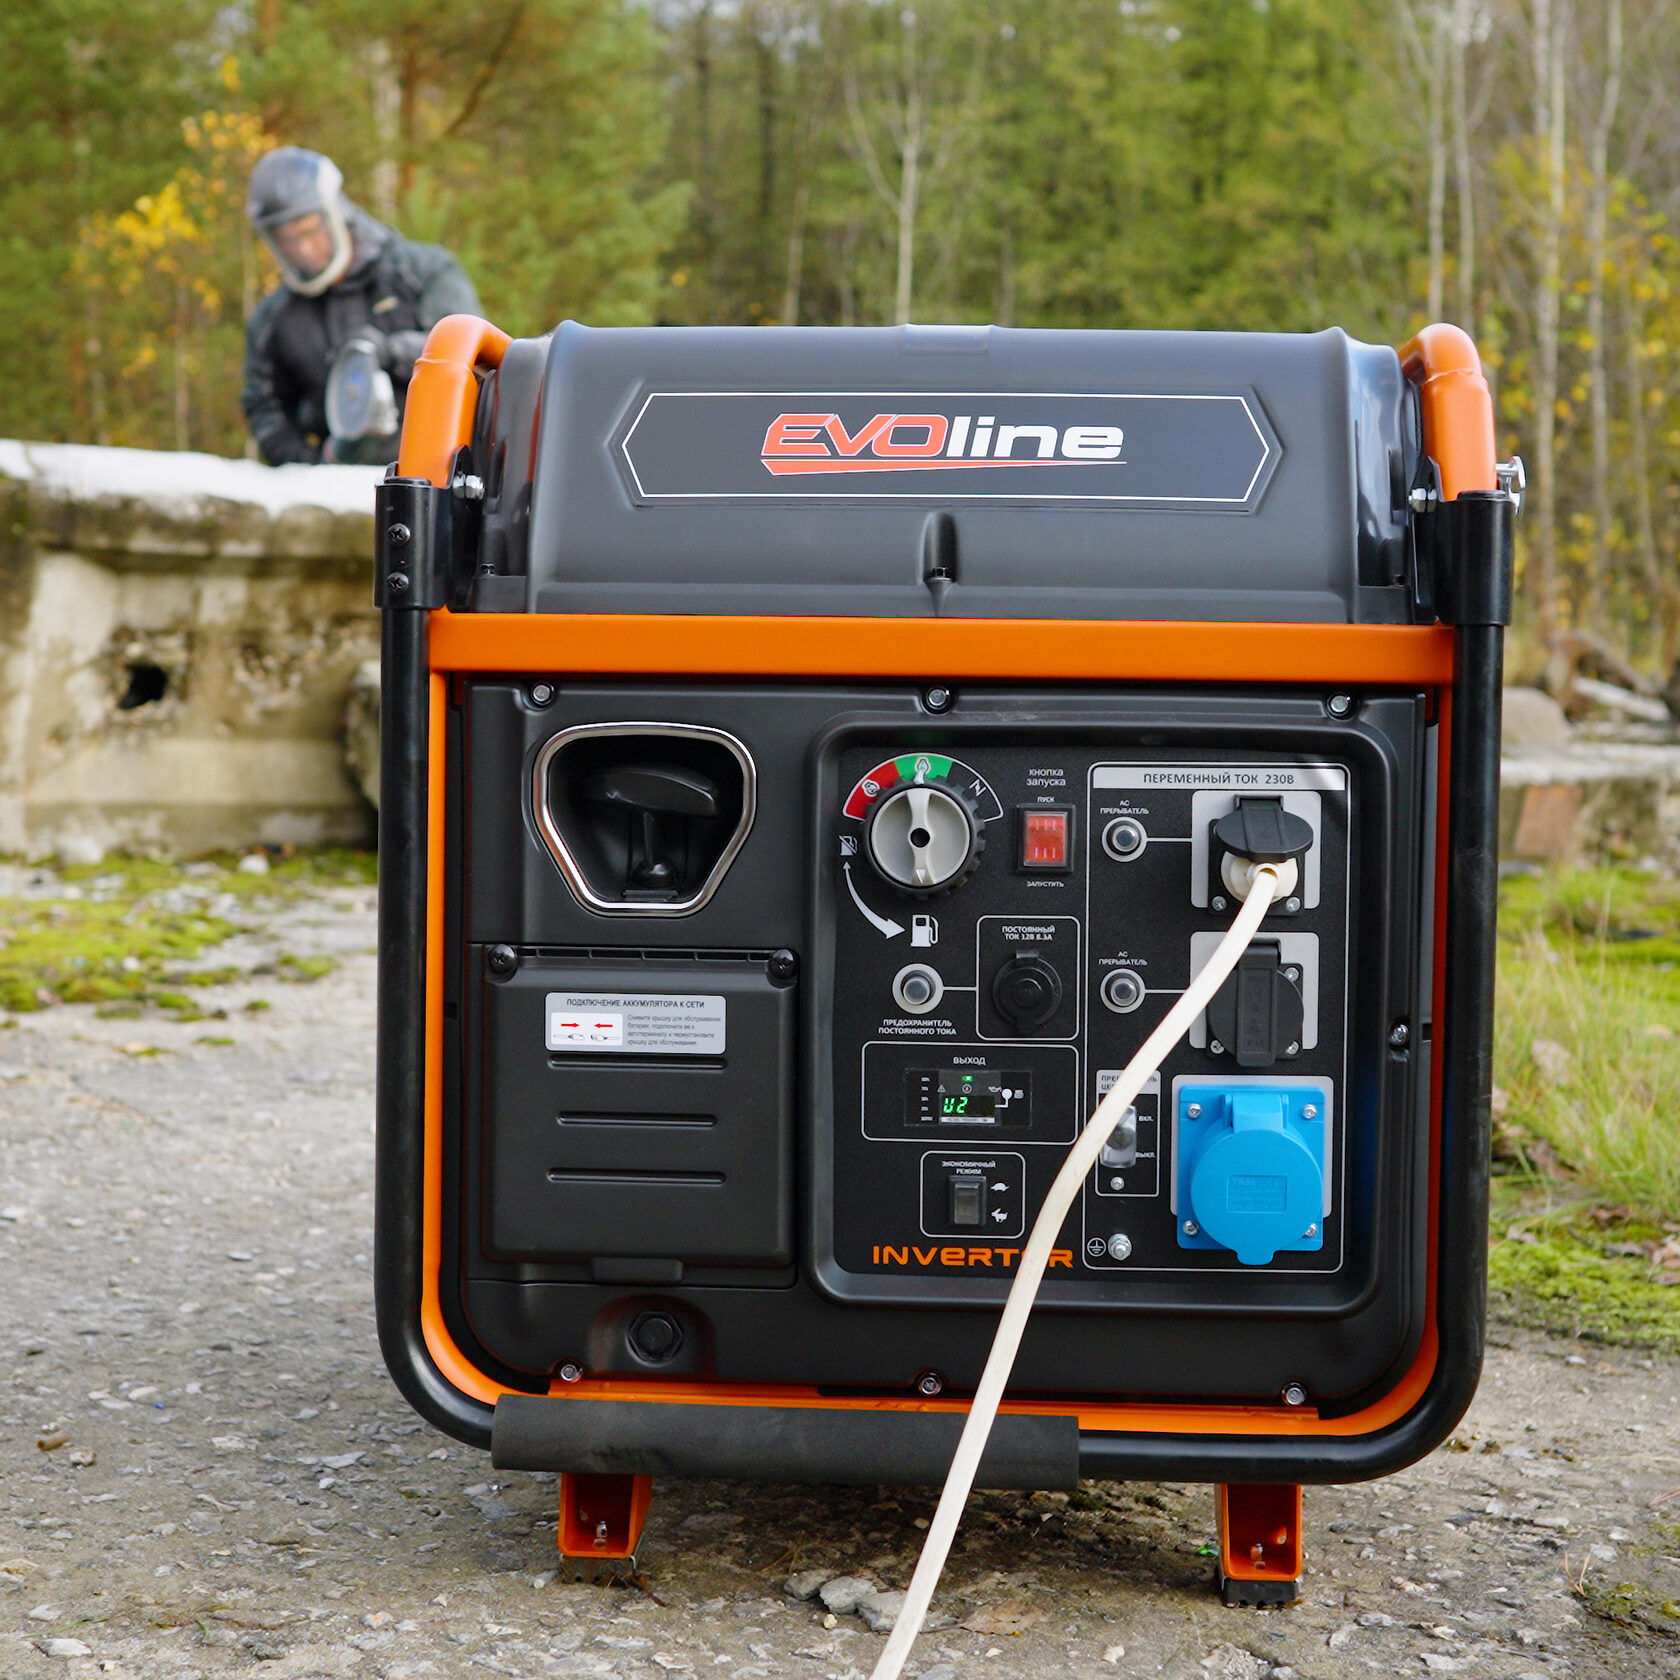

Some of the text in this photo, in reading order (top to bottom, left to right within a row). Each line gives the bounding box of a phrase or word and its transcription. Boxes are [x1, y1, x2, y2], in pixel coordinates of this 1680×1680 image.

[761, 413, 1124, 459] EVOline
[1028, 768, 1064, 777] кнопка
[1026, 777, 1067, 788] запуска
[1143, 771, 1295, 785] ПЕРЕМЕННЫЙ ТОК 230В
[1099, 807, 1150, 815] ПРЕРЫВАТЕЛЬ
[1001, 925, 1056, 934] ПОСТОЯННЫЙ
[1005, 933, 1020, 941] ТОК
[1098, 958, 1149, 966] ПРЕРЫВАТЕЛЬ
[566, 998, 621, 1007] ПОДКЛЮЧЕНИЕ
[622, 1000, 679, 1008] АККУМУЛЯТОРА
[882, 1018, 953, 1028] ПРЕДОХРАНИТЕЛЬ
[878, 1027, 957, 1036] ПОСТОЯННОГО ТОКА
[952, 1056, 986, 1066] ВЫХОД
[872, 1245, 1074, 1269] INVERTR
